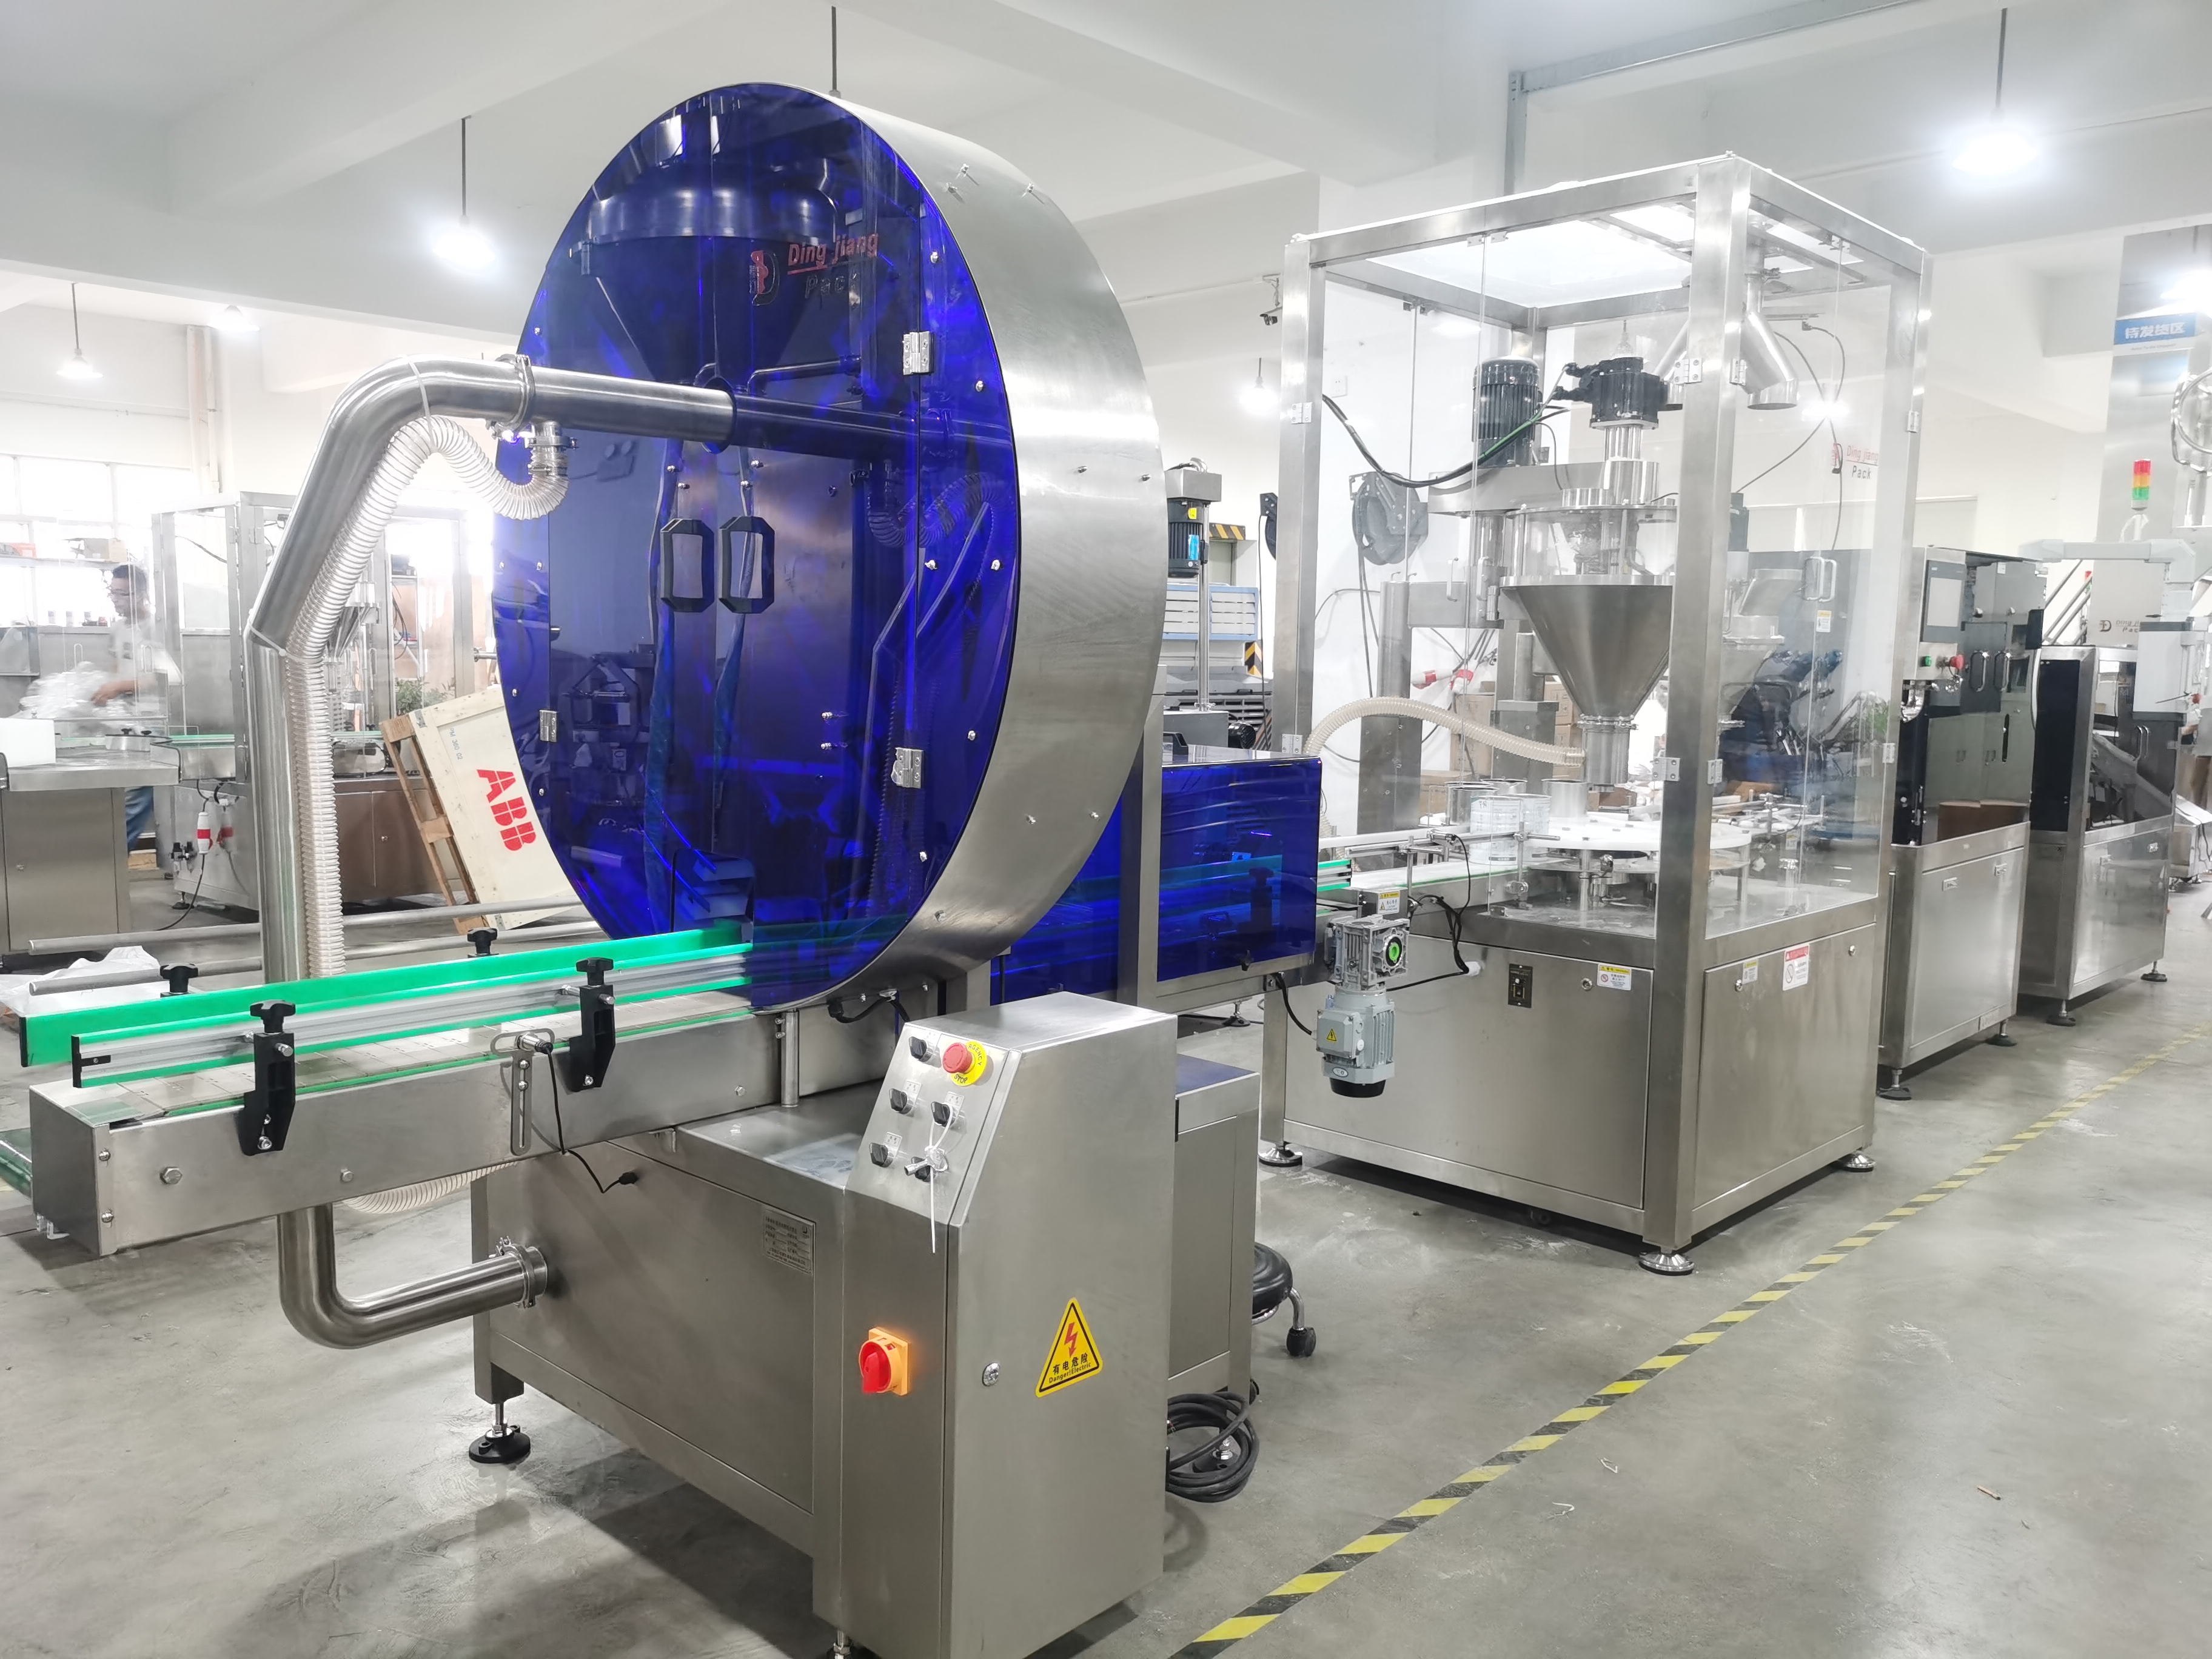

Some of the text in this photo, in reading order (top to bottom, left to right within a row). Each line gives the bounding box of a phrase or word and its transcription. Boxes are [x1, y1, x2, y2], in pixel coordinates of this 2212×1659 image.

[788, 233, 879, 267] Ding jiang
[1846, 446, 1861, 461] Ding
[1852, 465, 1871, 479] Pack
[477, 769, 537, 851] ABB
[954, 1073, 968, 1084] STOP
[1053, 1353, 1088, 1375] 有电危险
